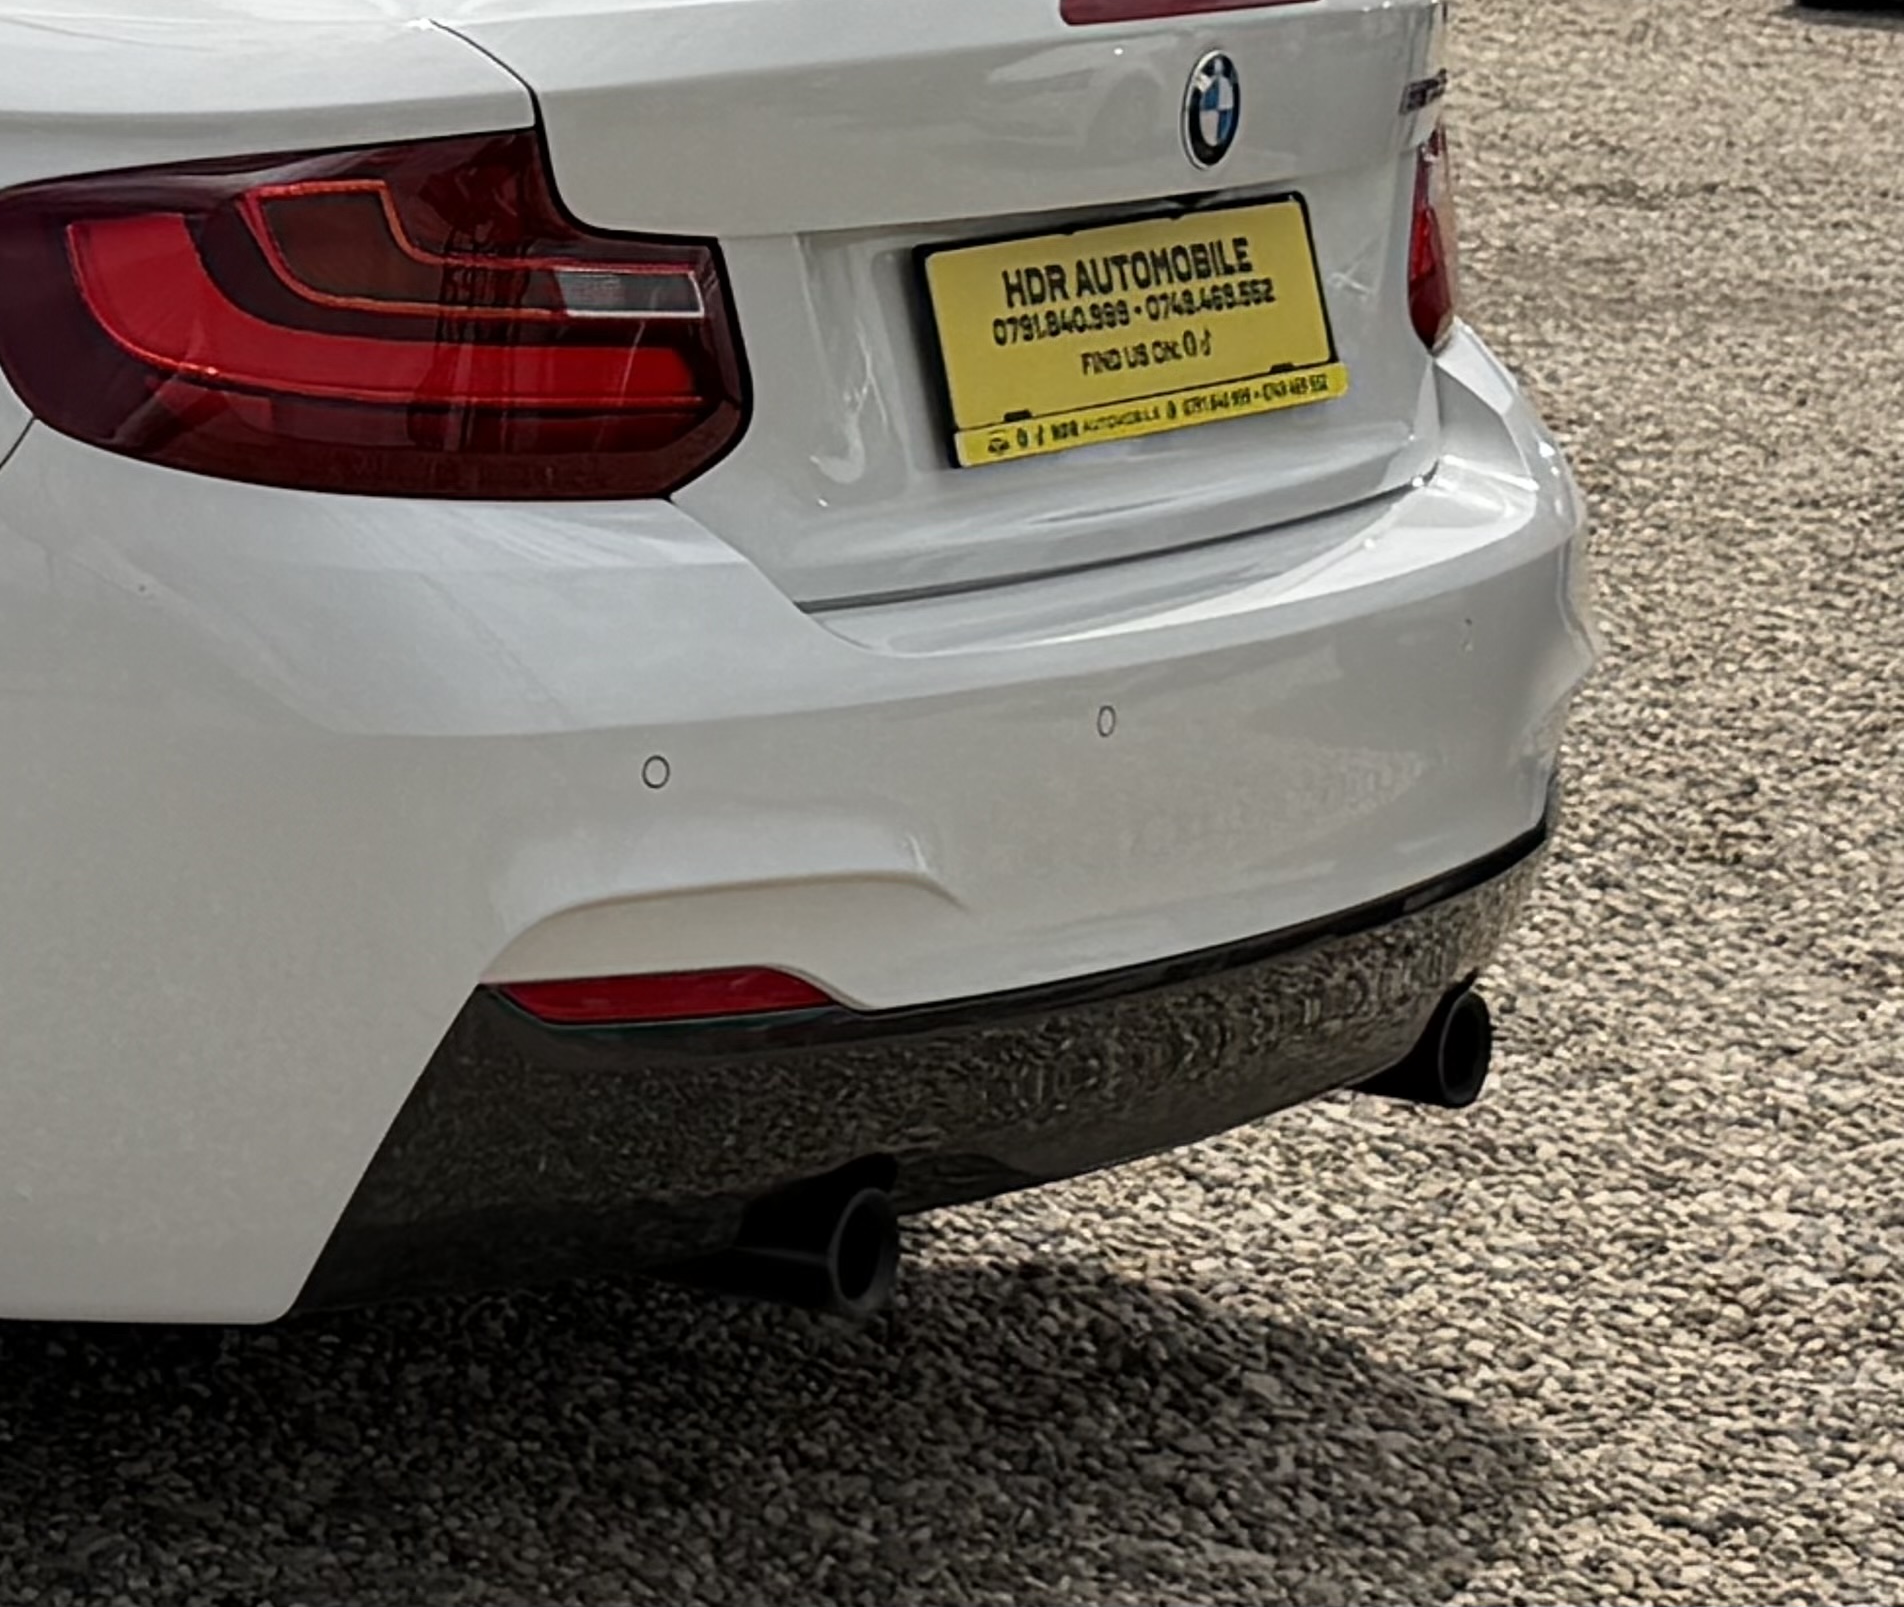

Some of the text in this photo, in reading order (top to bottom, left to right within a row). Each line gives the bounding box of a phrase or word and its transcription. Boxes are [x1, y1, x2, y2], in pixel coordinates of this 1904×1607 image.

[1001, 236, 1254, 309] HDR AUTOMOBILE
[1080, 347, 1124, 376] FIND
[1123, 341, 1150, 369] US
